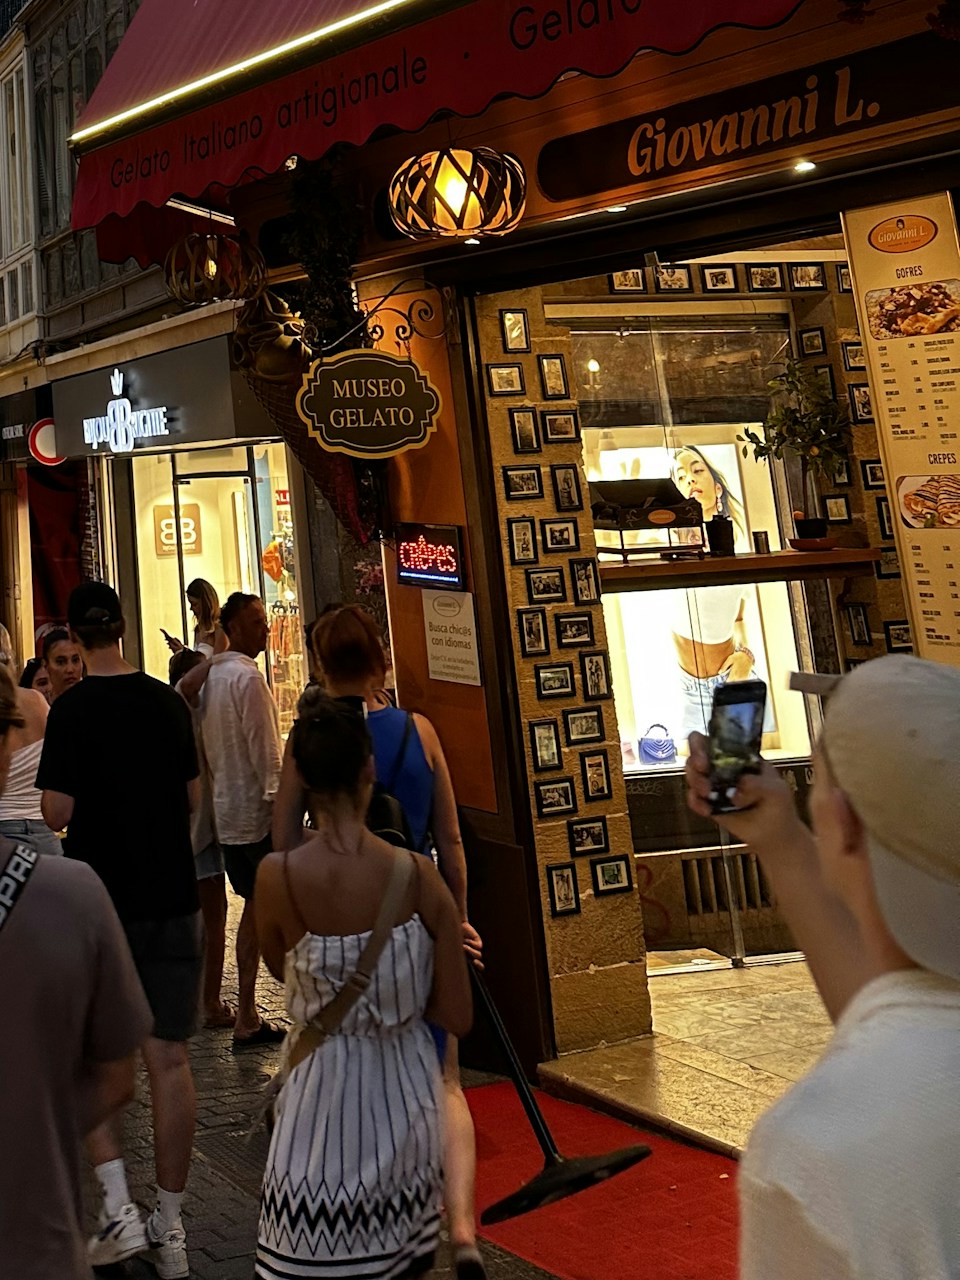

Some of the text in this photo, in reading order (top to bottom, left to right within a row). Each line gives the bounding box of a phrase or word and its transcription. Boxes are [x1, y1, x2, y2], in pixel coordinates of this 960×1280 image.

[110, 48, 428, 189] Gelato Italiano artigianale
[627, 66, 881, 177] Giovanni L.
[877, 225, 918, 243] Giovanni
[895, 265, 924, 279] GOFRES
[332, 378, 406, 398] MUSEO
[330, 407, 415, 428] GELATO
[928, 453, 957, 465] CREPES
[428, 621, 472, 636] Busca chic@s
[431, 636, 472, 650] con idiomas
